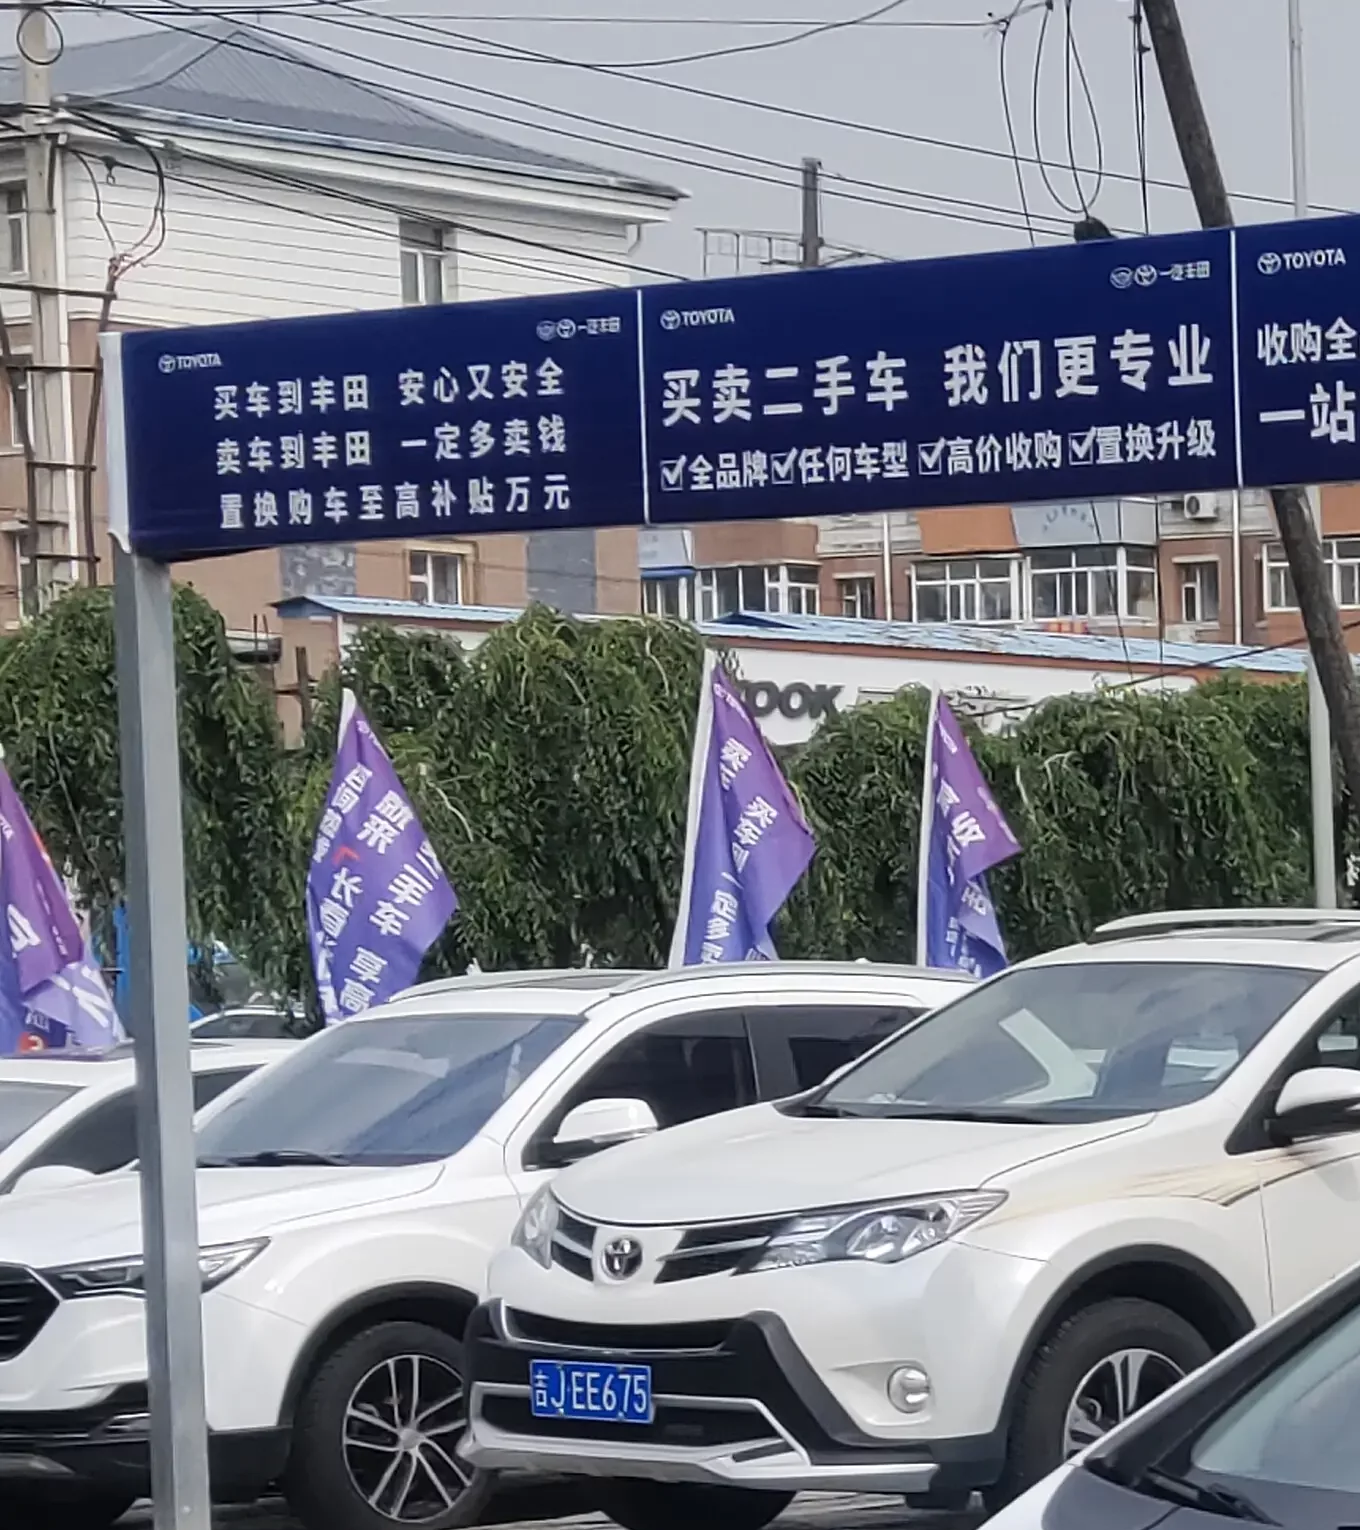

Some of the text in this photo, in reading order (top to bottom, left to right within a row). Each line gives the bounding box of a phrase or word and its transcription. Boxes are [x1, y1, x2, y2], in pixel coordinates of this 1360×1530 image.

[1282, 248, 1346, 269] TOYOTA
[682, 308, 734, 327] TOYOTA
[176, 352, 222, 370] TOYOTA
[213, 357, 564, 420] 买车到丰田 安心又安全
[662, 324, 1214, 426] 买卖二手车 我们更专业
[216, 414, 568, 476] 卖车到丰田 一定多卖钱
[690, 417, 1216, 491] 全品牌 任何车型 高价收购 置换升级
[219, 473, 571, 529] 置换购车至高补贴万元
[533, 1368, 648, 1414] 吉JEE675
